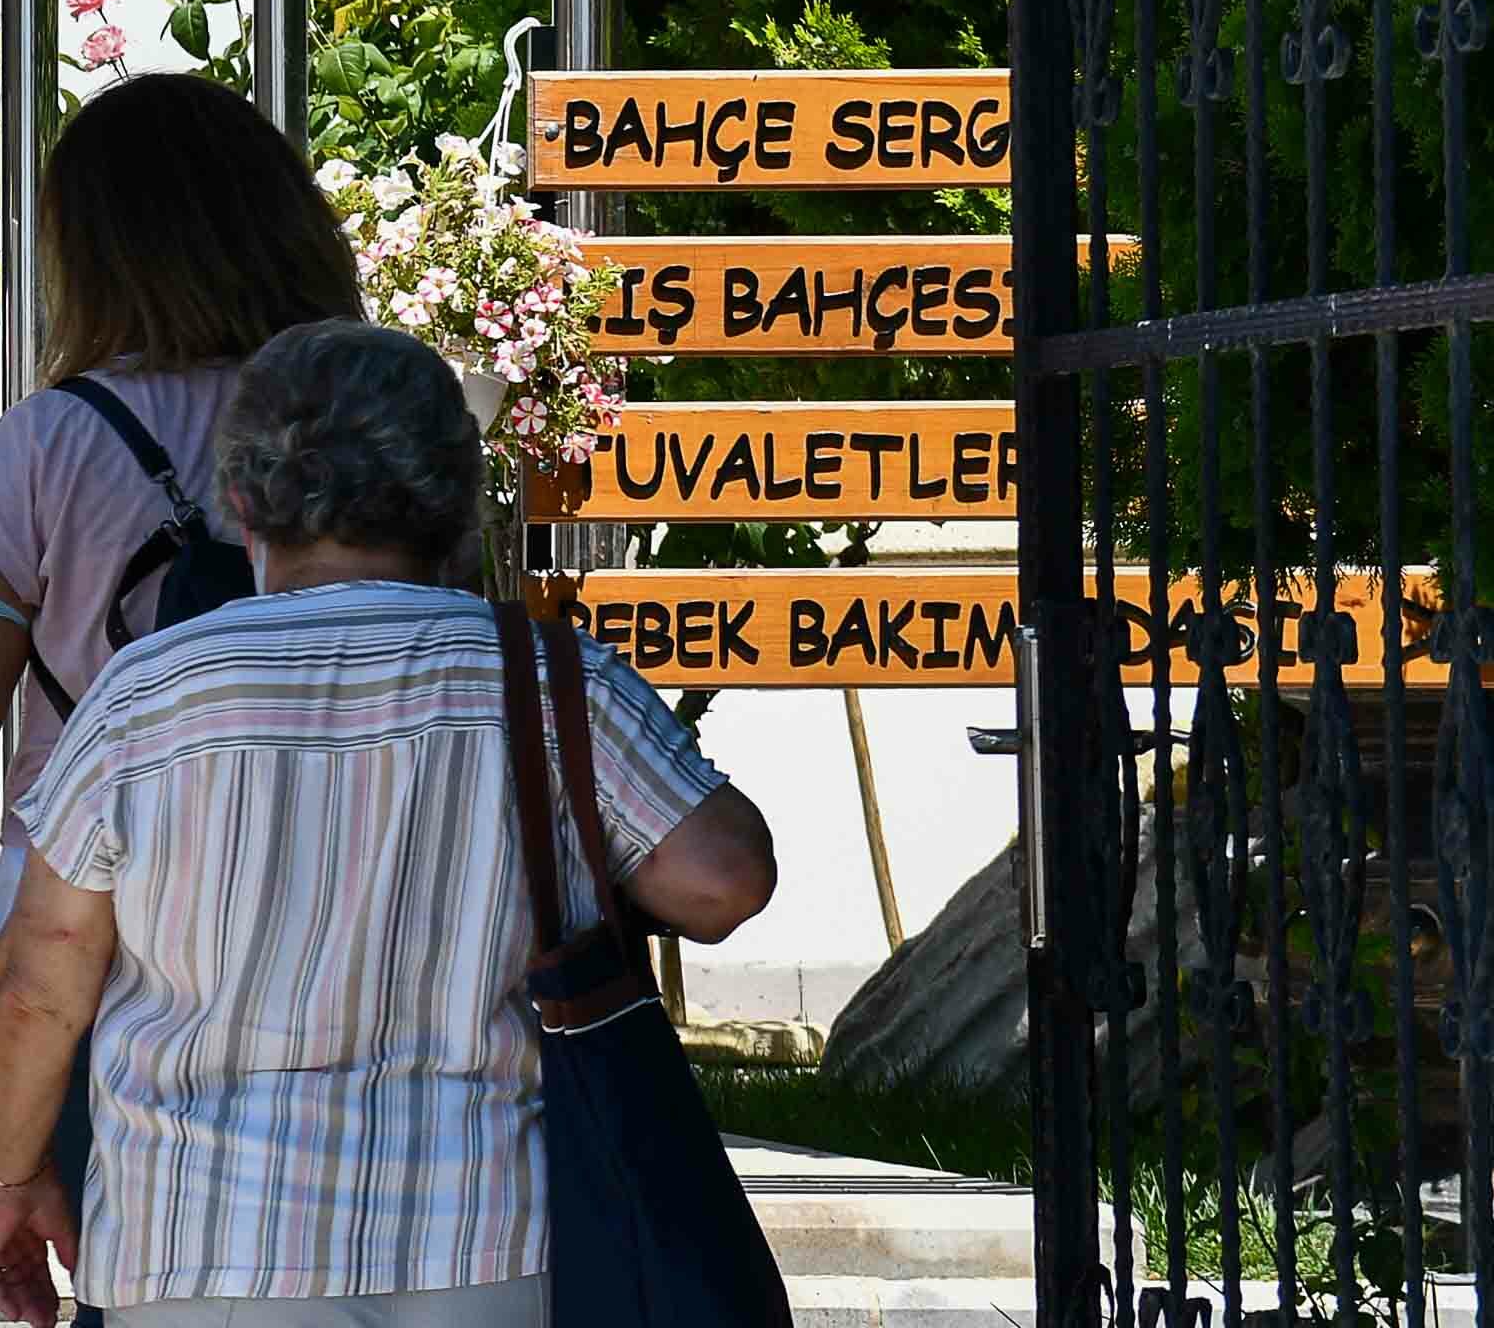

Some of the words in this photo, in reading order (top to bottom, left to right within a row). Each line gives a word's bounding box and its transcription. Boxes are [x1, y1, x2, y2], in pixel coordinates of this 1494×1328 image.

[563, 98, 796, 184] BAHÇE
[825, 99, 1012, 170] SERG
[588, 265, 696, 346] IŞ
[789, 598, 1022, 670] BAKIM
